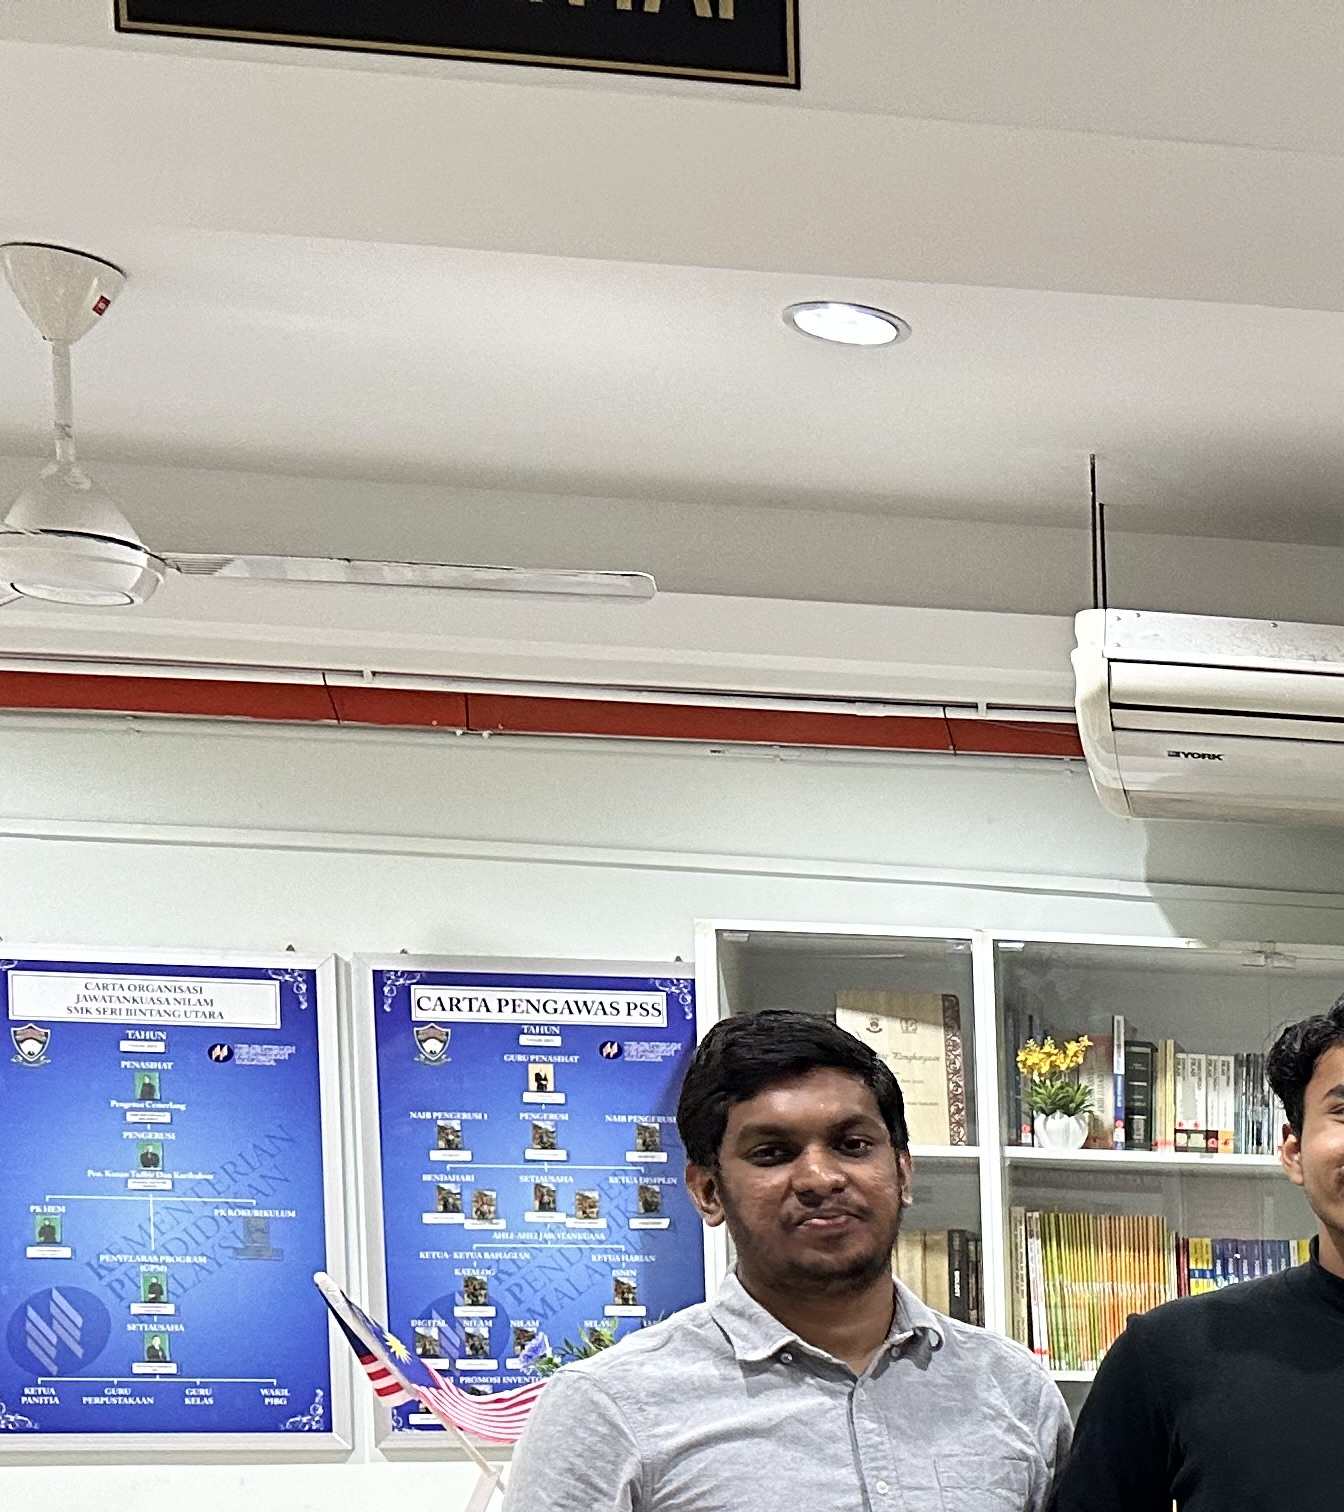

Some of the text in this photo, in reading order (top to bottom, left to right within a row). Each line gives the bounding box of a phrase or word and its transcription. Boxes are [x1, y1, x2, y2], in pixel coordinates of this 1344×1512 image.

[1181, 751, 1223, 761] YORK
[84, 982, 203, 995] CARTA ORGANISASI
[75, 994, 214, 1007] JAWATANKUASA NILAM
[416, 995, 662, 1018] CARTA PENGAWAS PSS
[66, 1006, 224, 1020] SMK SERI BINTANG UTARA
[126, 1030, 167, 1040] TAHUN
[522, 1026, 560, 1035] TAHUN
